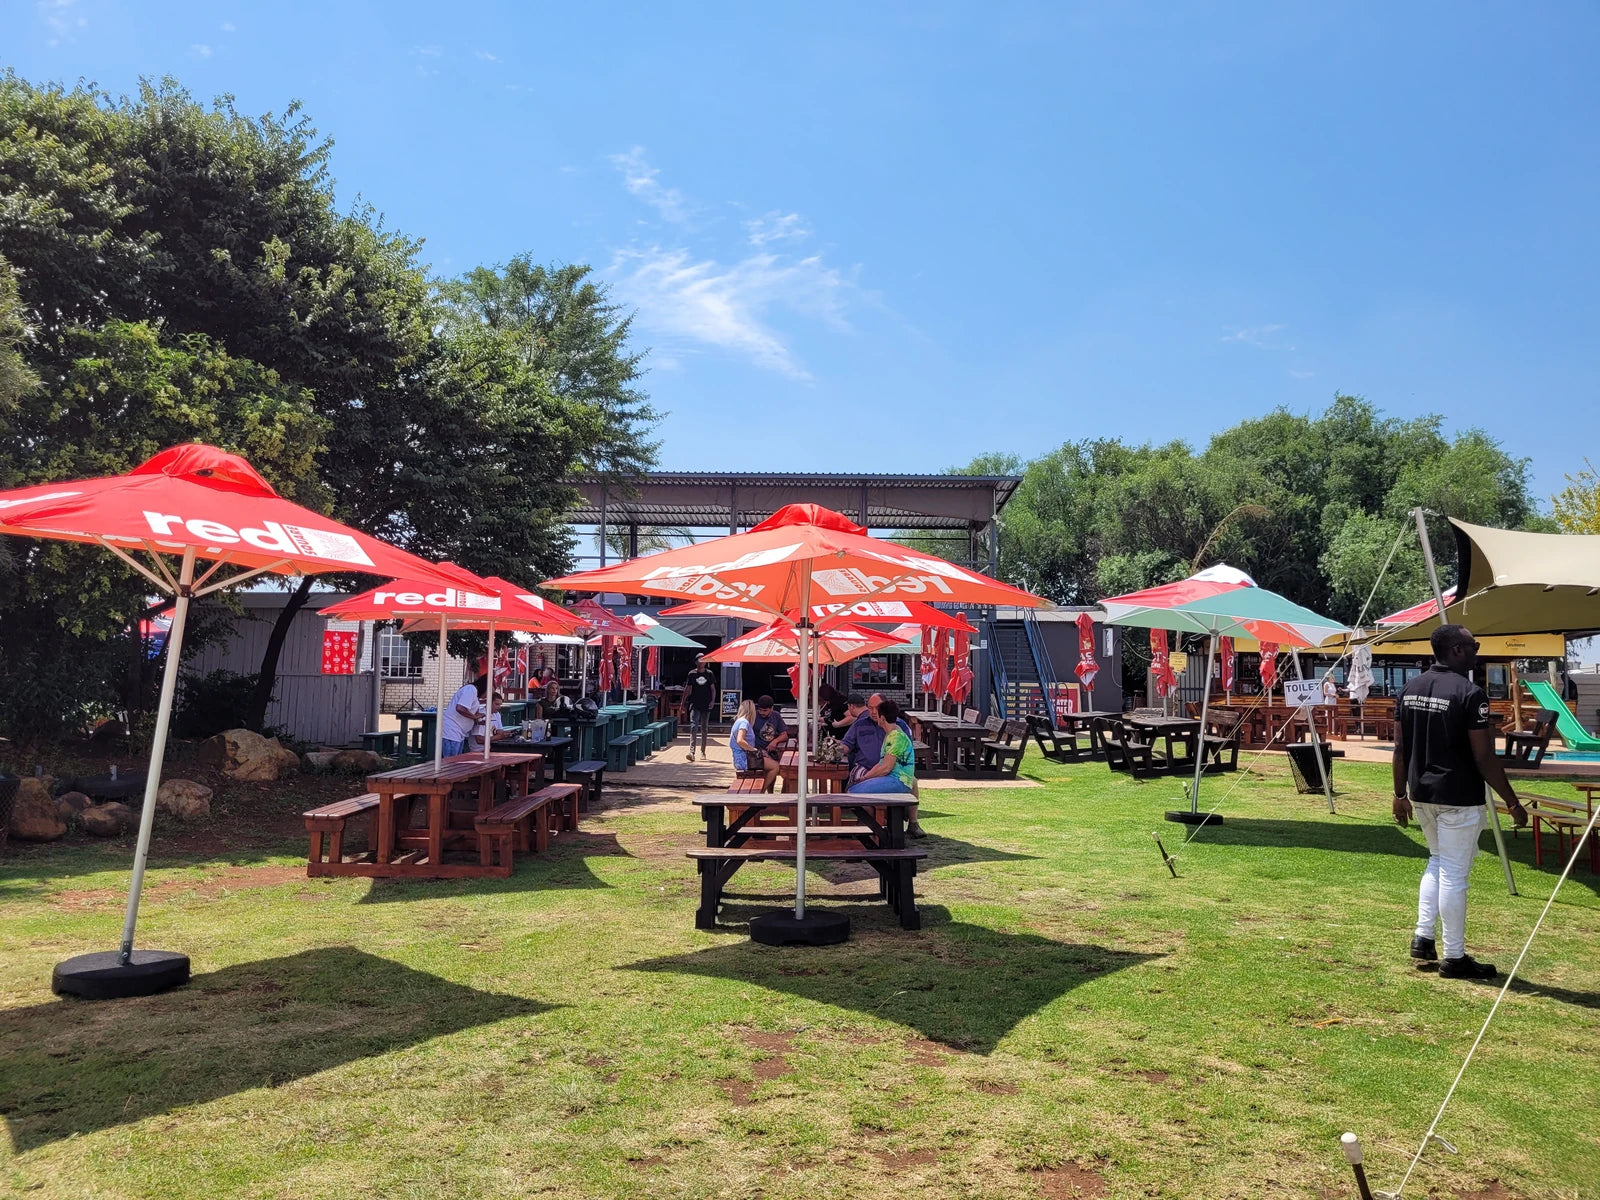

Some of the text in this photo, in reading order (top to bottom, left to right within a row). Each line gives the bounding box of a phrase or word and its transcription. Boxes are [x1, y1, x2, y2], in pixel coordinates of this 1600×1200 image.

[142, 510, 301, 555] red
[287, 524, 318, 556] SQUARE
[373, 587, 456, 607] red
[1285, 682, 1320, 693] TOILET
